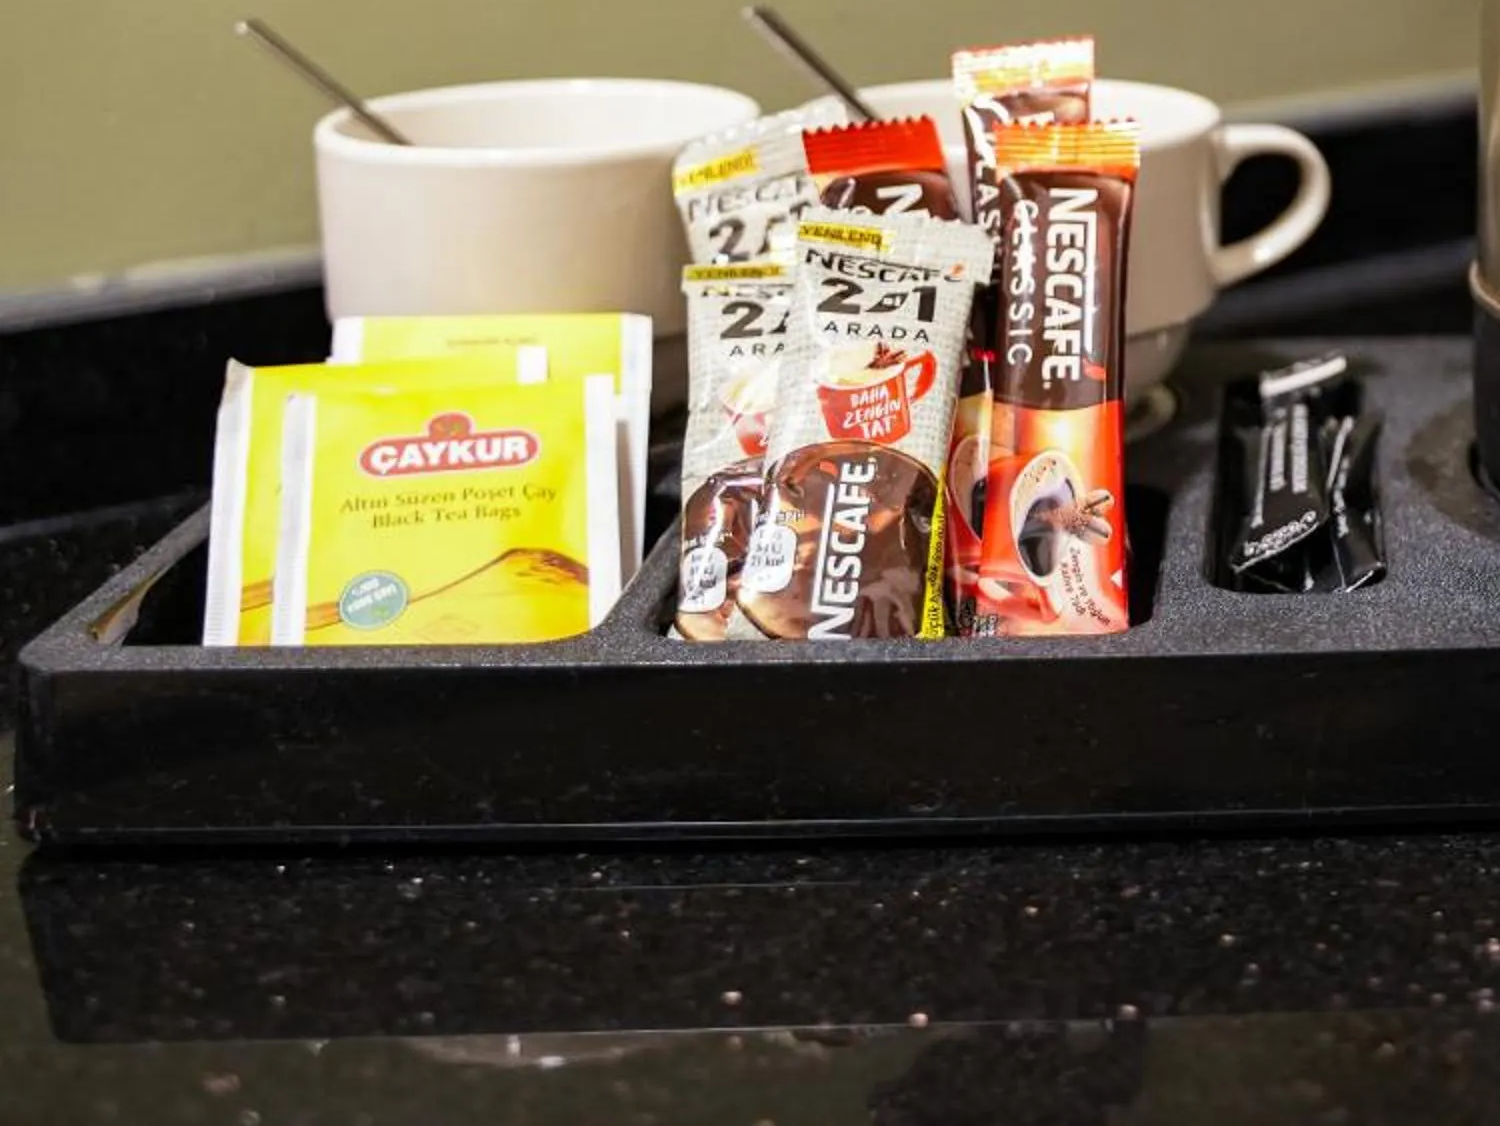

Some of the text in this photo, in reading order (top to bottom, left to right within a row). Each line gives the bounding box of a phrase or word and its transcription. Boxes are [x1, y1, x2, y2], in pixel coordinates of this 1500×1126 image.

[824, 321, 930, 343] ARADA
[729, 342, 785, 357] ARA
[860, 415, 898, 439] TAT
[370, 436, 529, 475] ÇAYKUR
[372, 505, 522, 530] Black Tea Bags
